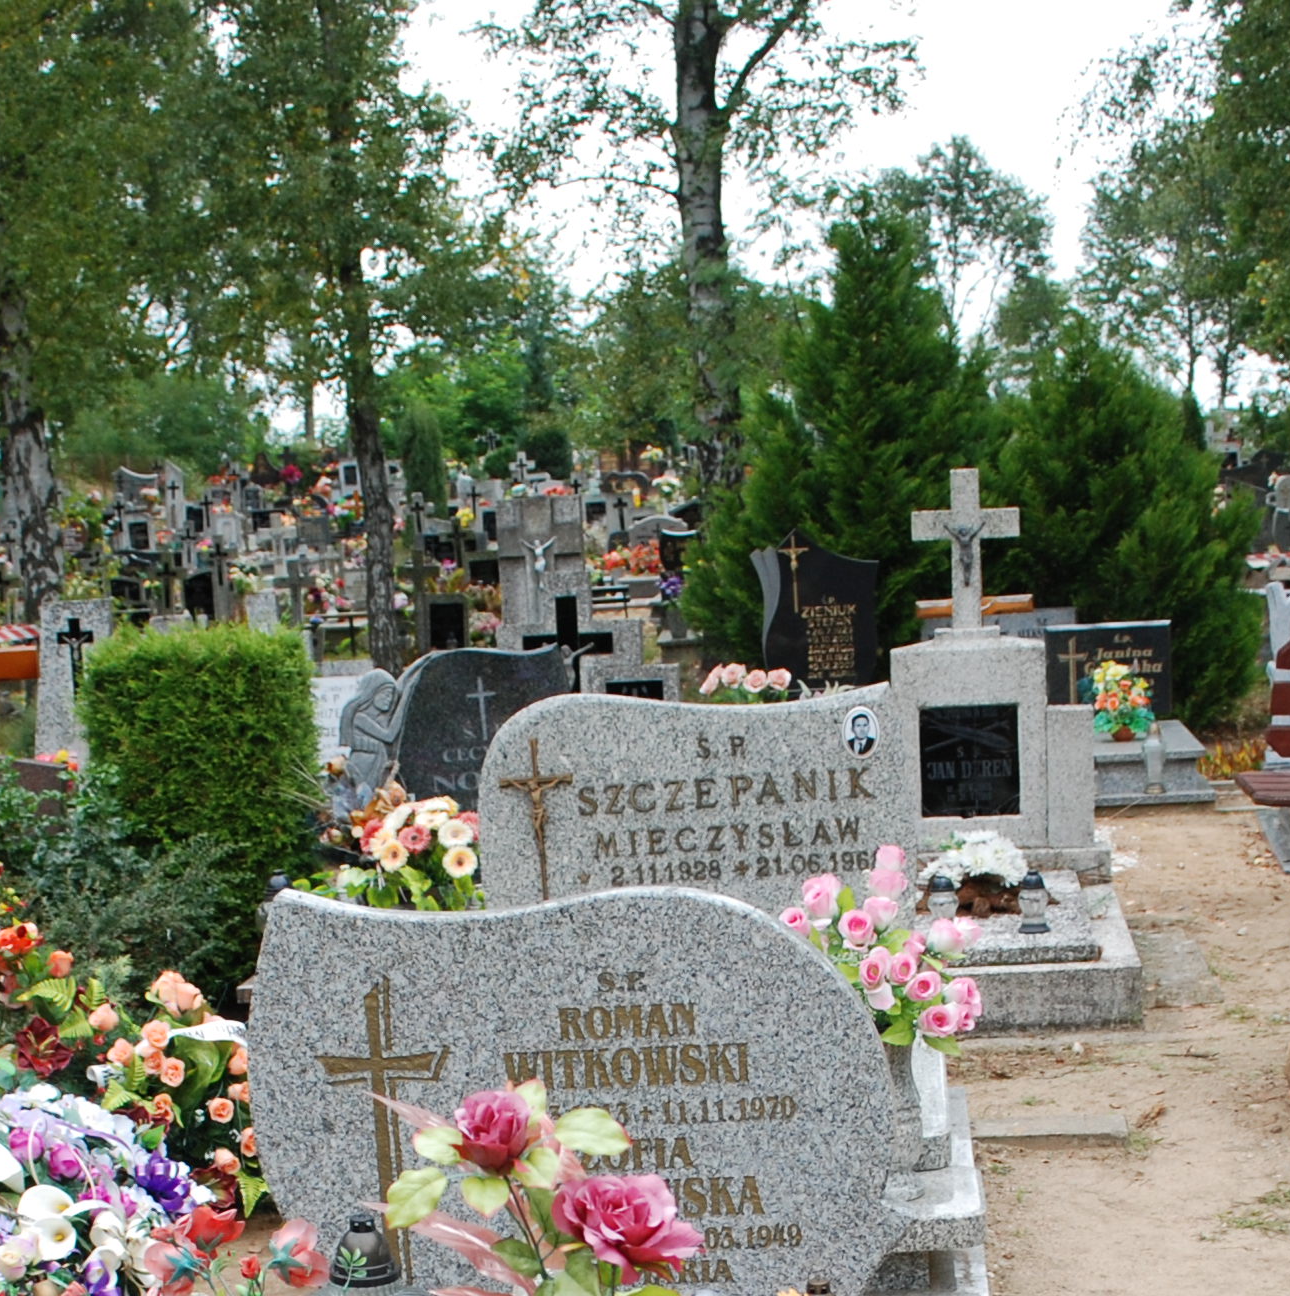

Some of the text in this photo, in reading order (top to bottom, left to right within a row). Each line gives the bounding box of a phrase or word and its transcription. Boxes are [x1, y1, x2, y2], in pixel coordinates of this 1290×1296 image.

[800, 604, 857, 618] ZIENIUK
[577, 766, 877, 817] SZCZEPANIK
[594, 816, 861, 859] MIECZYSŁAW
[559, 1002, 697, 1041] ROMAN
[503, 1042, 751, 1090] WITKOWSKI
[661, 1095, 797, 1125] 11.11.1970
